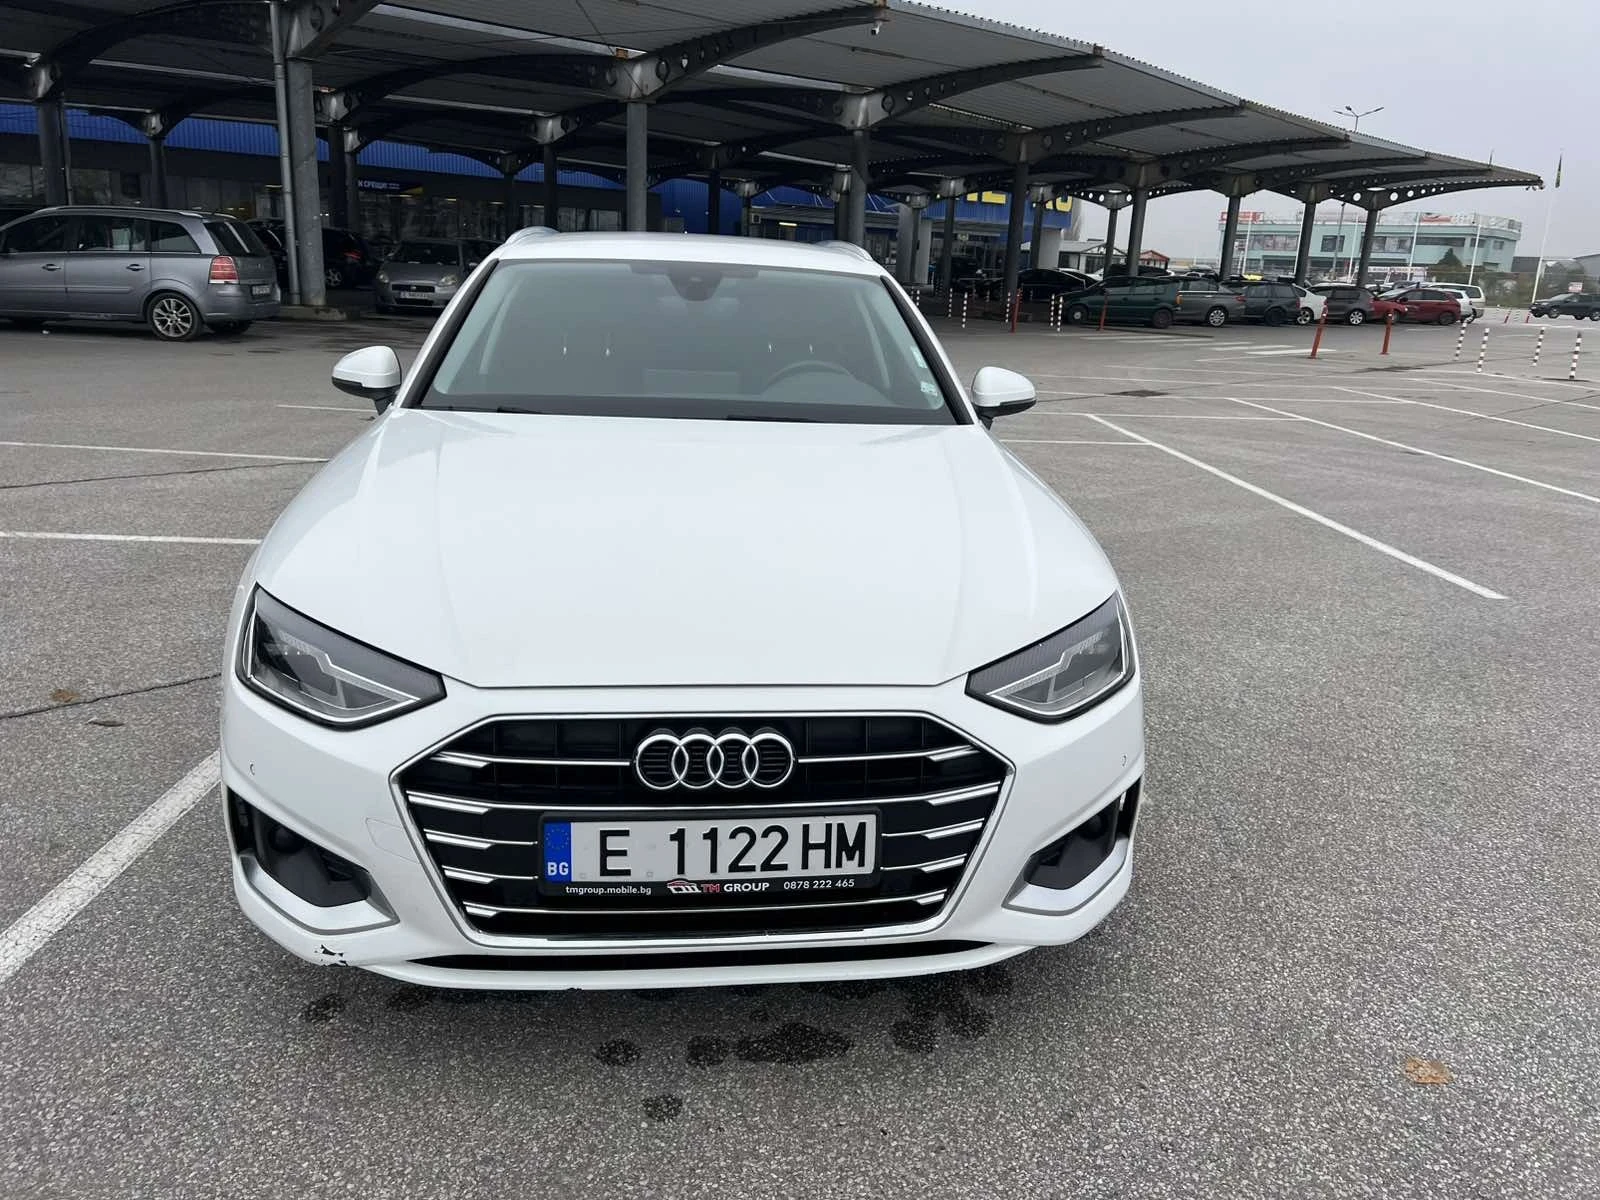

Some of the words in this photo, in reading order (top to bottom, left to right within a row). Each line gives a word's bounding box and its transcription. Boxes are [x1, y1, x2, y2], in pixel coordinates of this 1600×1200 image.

[599, 829, 631, 877] E
[669, 824, 789, 876] 1122
[800, 821, 867, 870] HM
[547, 862, 569, 876] BG
[701, 883, 720, 893] TM
[723, 882, 770, 892] GROUP
[783, 880, 810, 890] 0878
[812, 879, 832, 889] 222
[835, 878, 855, 888] 465
[565, 885, 652, 896] tmgroup.mobile.bg
